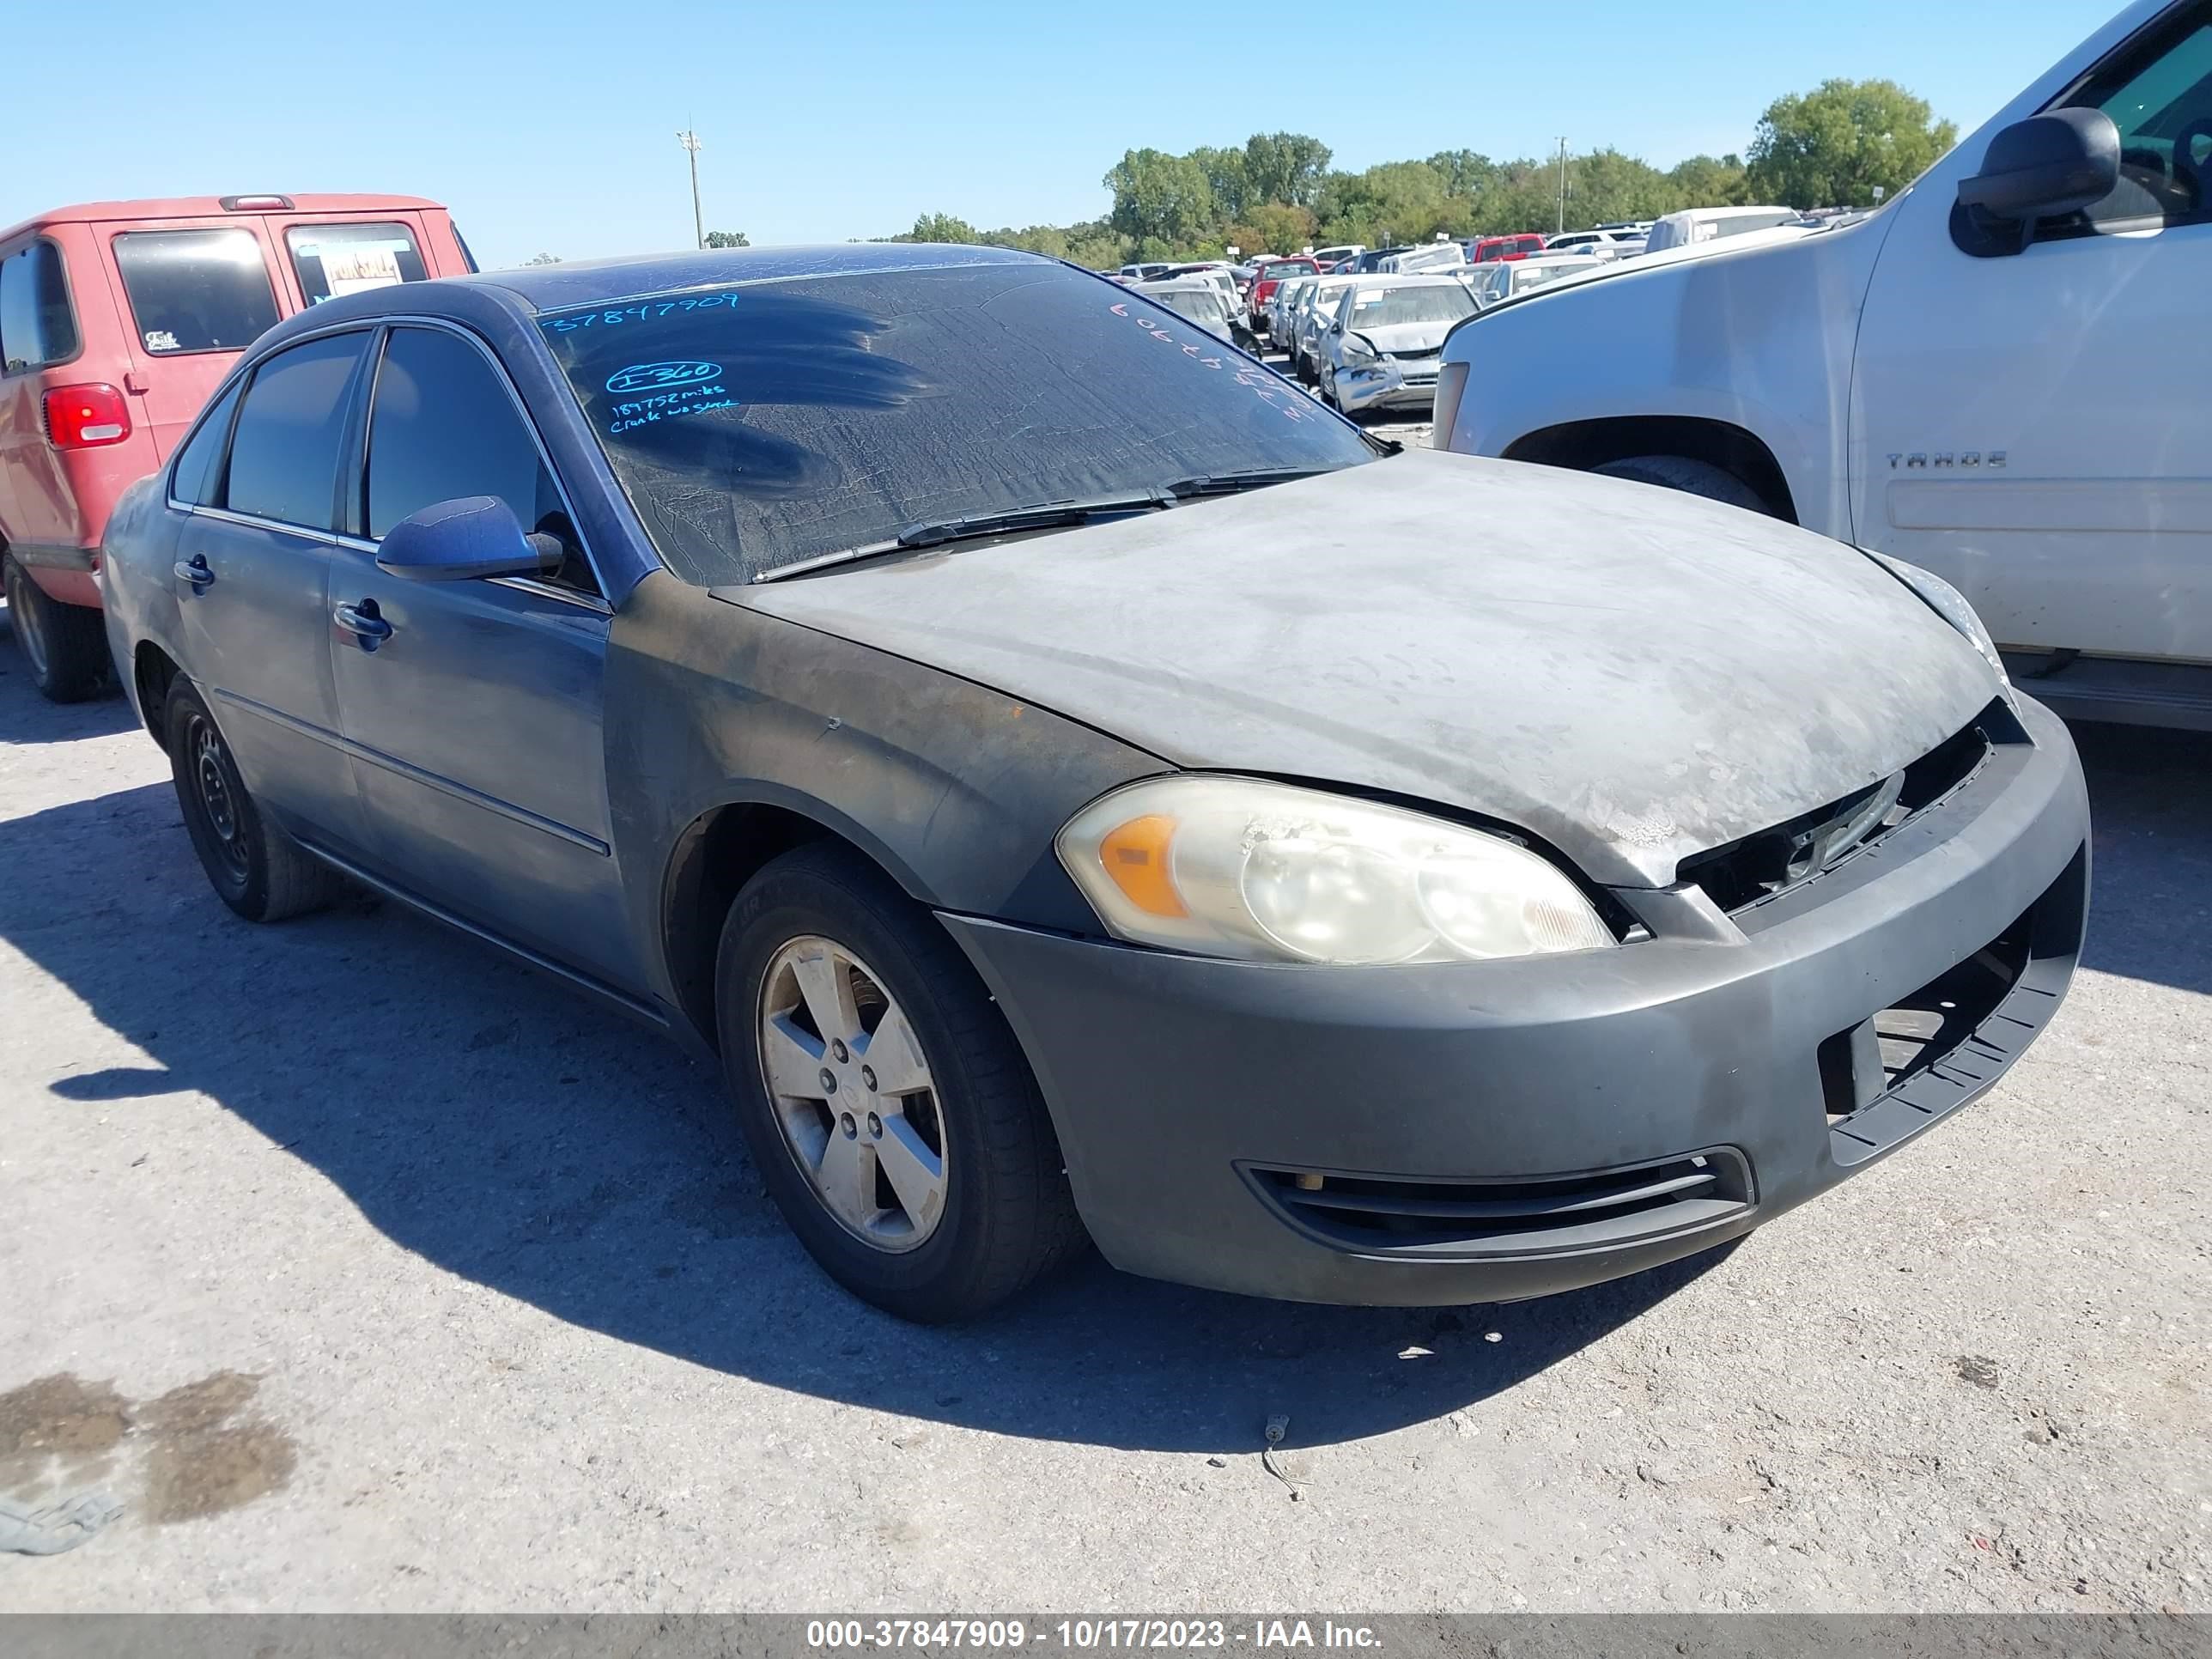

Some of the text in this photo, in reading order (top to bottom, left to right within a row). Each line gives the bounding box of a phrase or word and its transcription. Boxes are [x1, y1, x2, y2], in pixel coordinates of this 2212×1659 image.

[542, 293, 739, 331] 37847909
[612, 392, 679, 418] 189752
[1887, 451, 2007, 470] TAHOE
